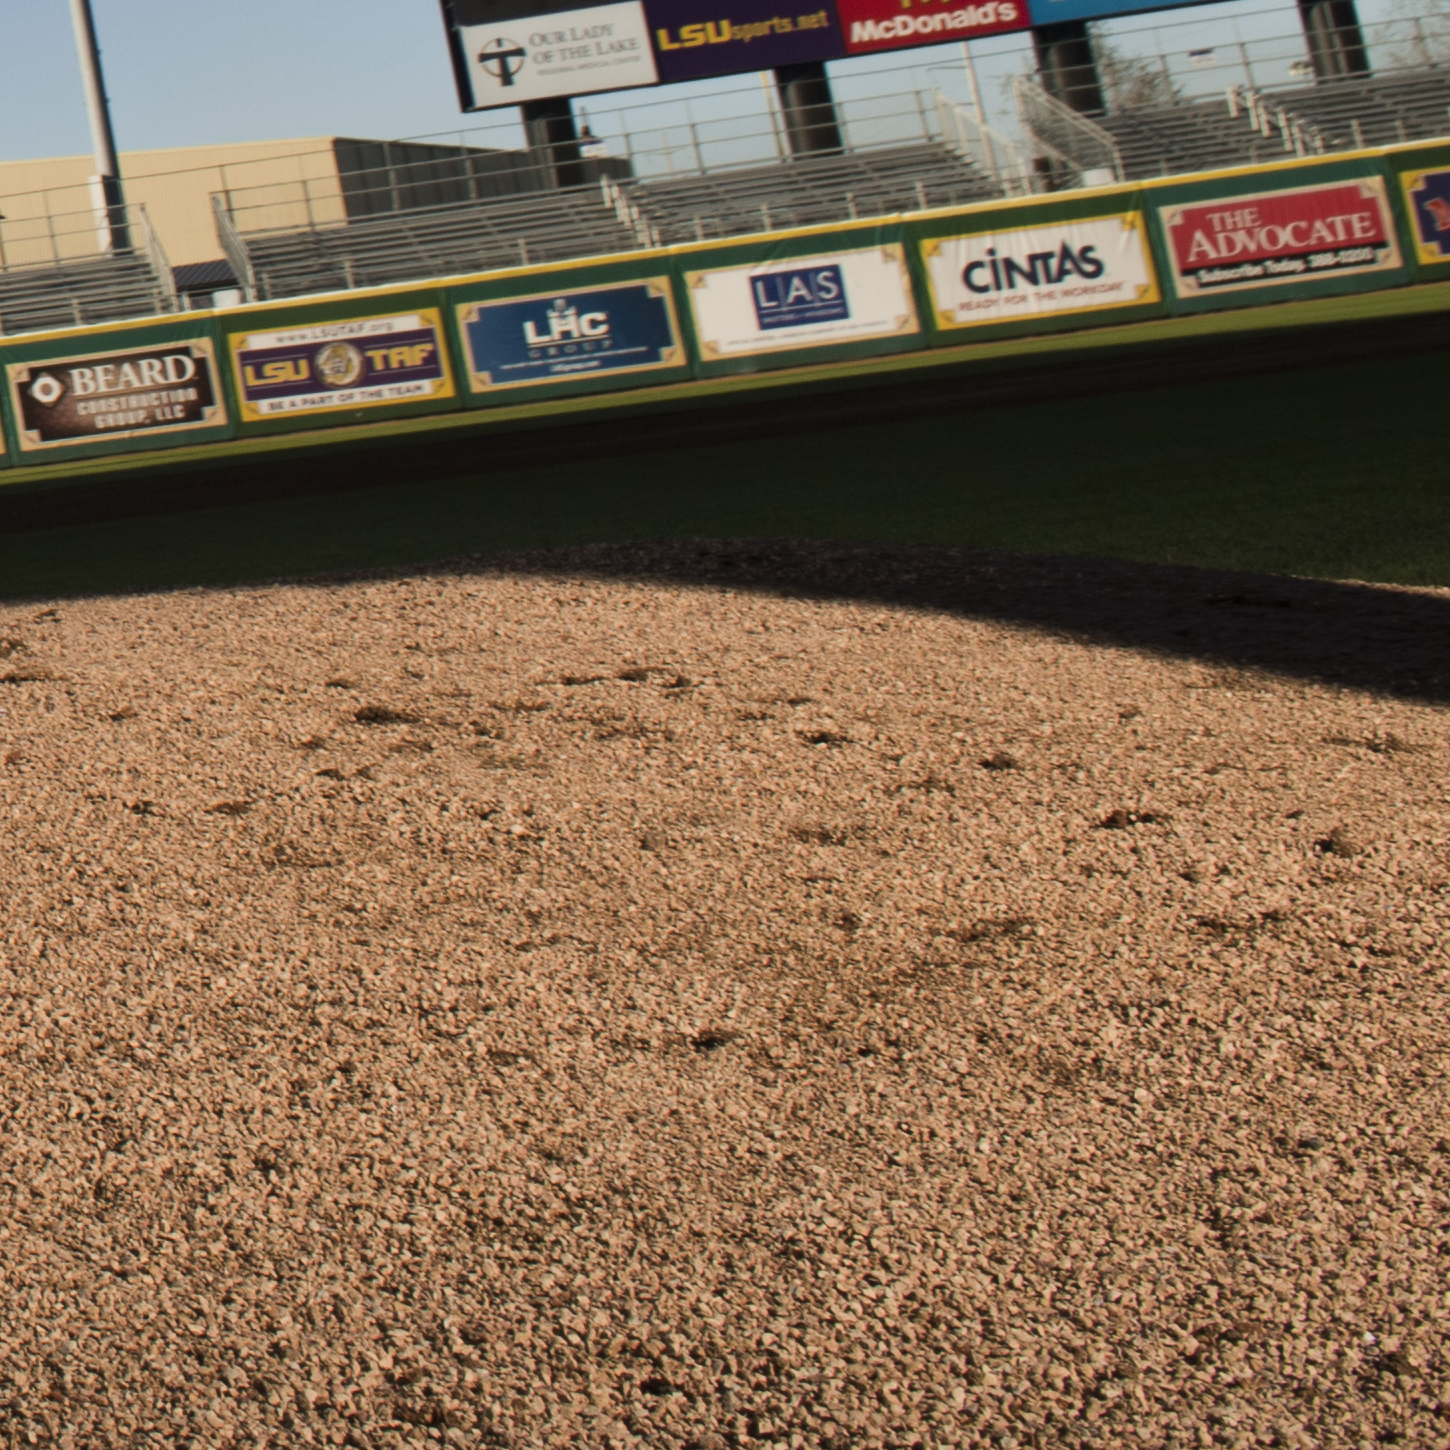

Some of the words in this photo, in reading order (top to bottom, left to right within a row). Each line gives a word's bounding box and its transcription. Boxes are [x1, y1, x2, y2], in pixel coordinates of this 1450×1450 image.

[529, 30, 568, 47] OUR
[570, 23, 615, 41] LADY
[850, 0, 1019, 44] McDonald's
[532, 50, 555, 65] OF
[558, 45, 593, 61] THE
[594, 37, 640, 56] LAKE
[1206, 207, 1262, 232] THE
[1187, 212, 1376, 263] ADVOCATE
[523, 305, 610, 345] LHC
[69, 354, 196, 397] BEARD
[244, 358, 311, 387] LSU
[365, 343, 434, 372] TAF
[76, 387, 198, 415] CONSTRUCTION
[268, 401, 284, 412] BE
[289, 398, 300, 409] A
[302, 394, 334, 406] PART
[337, 391, 354, 402] OF
[360, 387, 384, 400] THE
[388, 383, 425, 397] TEAM
[155, 404, 186, 421] LLC
